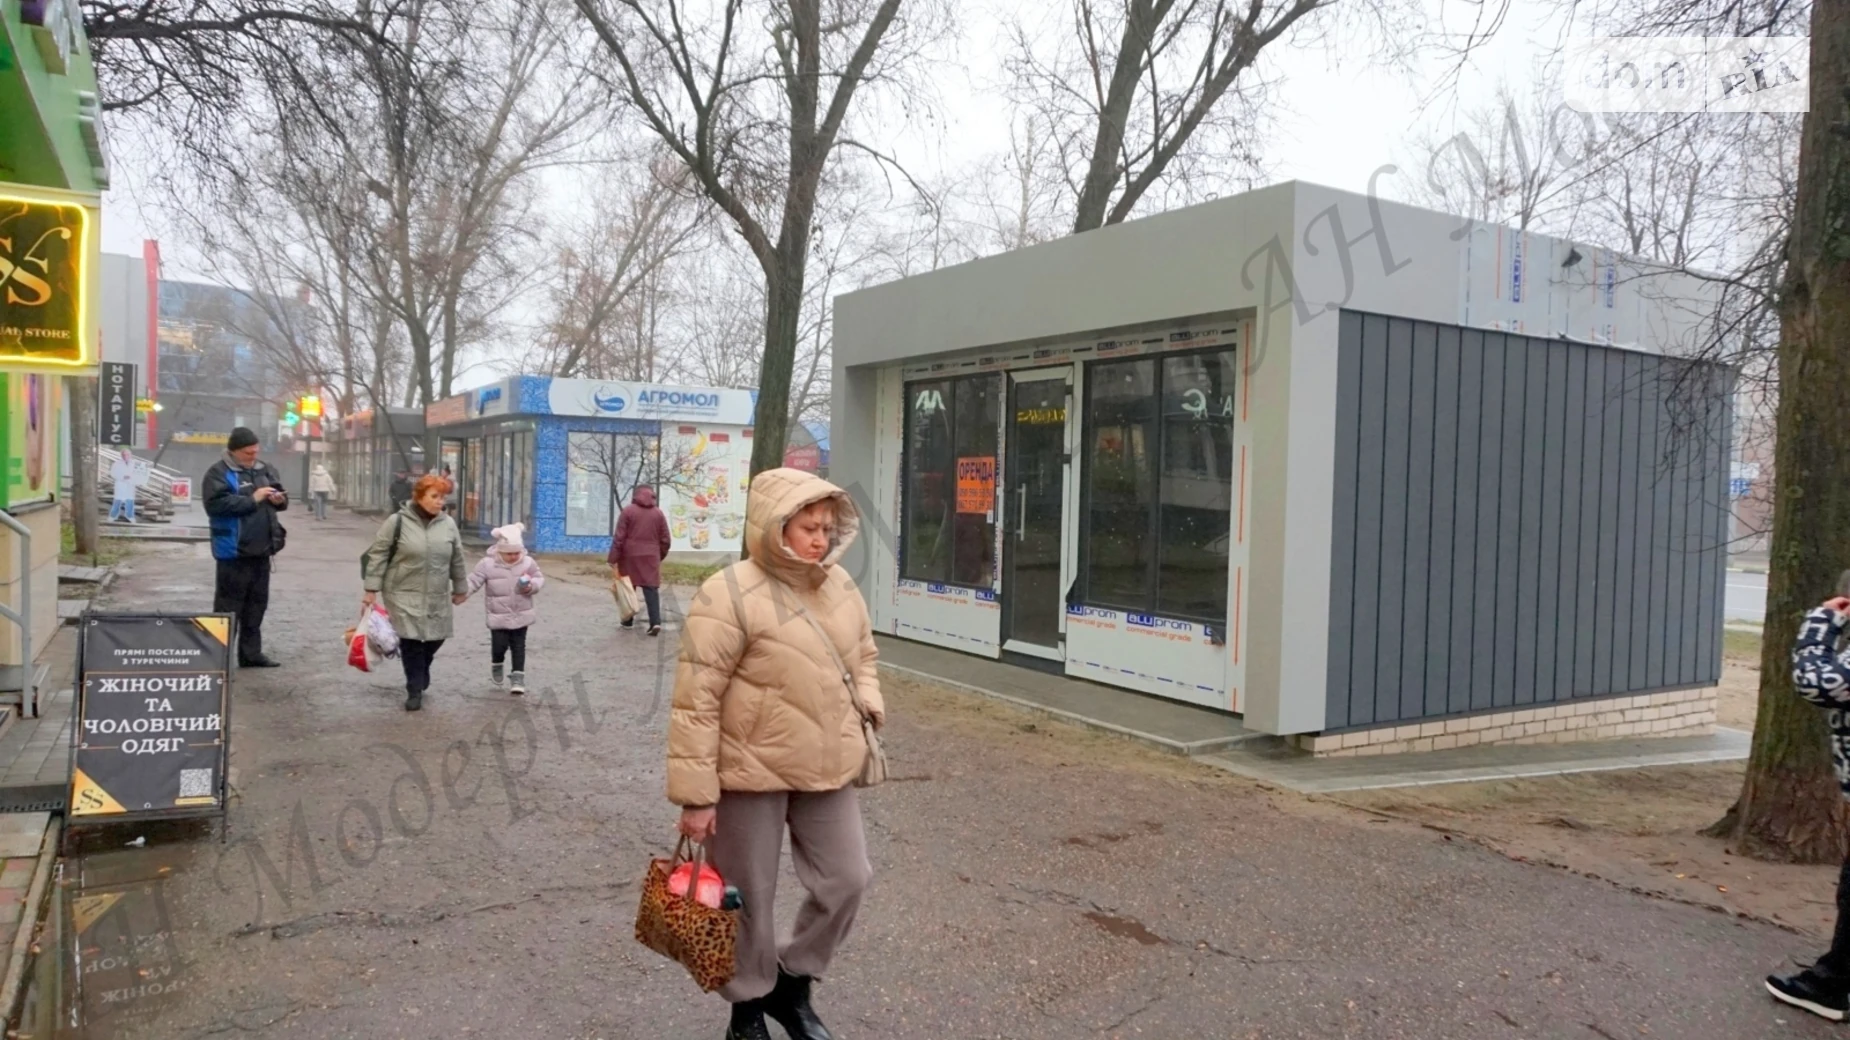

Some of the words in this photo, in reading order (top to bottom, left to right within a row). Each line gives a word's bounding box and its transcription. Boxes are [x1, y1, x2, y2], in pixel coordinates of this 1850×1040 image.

[25, 328, 70, 339] STORE
[111, 365, 124, 443] НОТАРІУС
[638, 390, 720, 409] АГРОМОЛ
[960, 461, 993, 483] ОРЕНДА
[1126, 626, 1168, 638] commercial
[1169, 632, 1192, 643] grade
[114, 649, 146, 657] ПРЯМІ
[148, 648, 201, 657] ПОСТАВКИ
[122, 658, 128, 666] З
[131, 657, 190, 666] ТУРЕЧЧИНИ
[98, 674, 212, 693] ЖІНОЧИЙ
[144, 697, 173, 713] ТА
[84, 713, 222, 734] ЧОЛОВІЧИЙ
[121, 737, 185, 756] ОДЯГ
